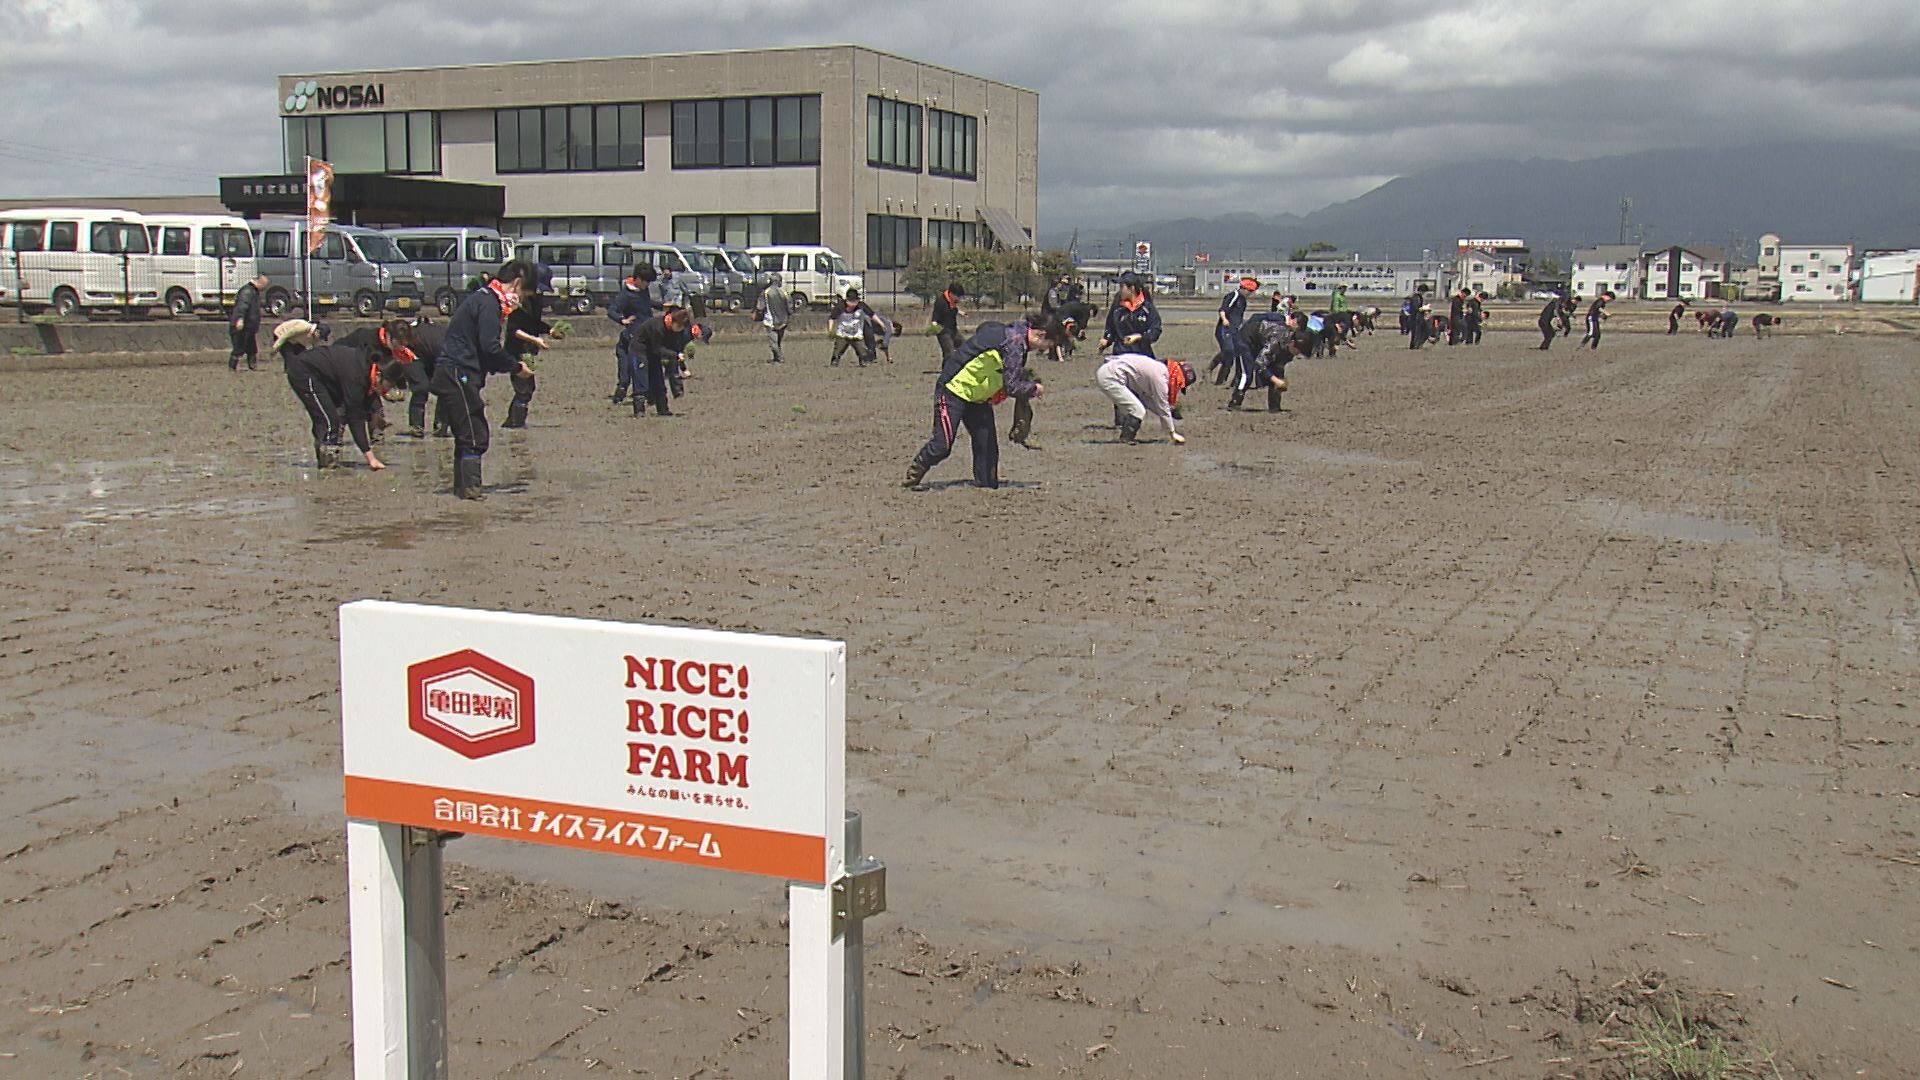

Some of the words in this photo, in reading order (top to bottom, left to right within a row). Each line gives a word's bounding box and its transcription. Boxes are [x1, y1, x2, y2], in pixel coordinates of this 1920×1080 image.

[317, 83, 384, 108] NOSAI
[623, 654, 749, 699] NICE!
[429, 688, 514, 719] 亀田製菓
[625, 699, 749, 744] RICE!
[626, 741, 749, 788] FARM
[433, 797, 522, 831] 合同会社
[527, 810, 723, 859] ナイスライスファーム
